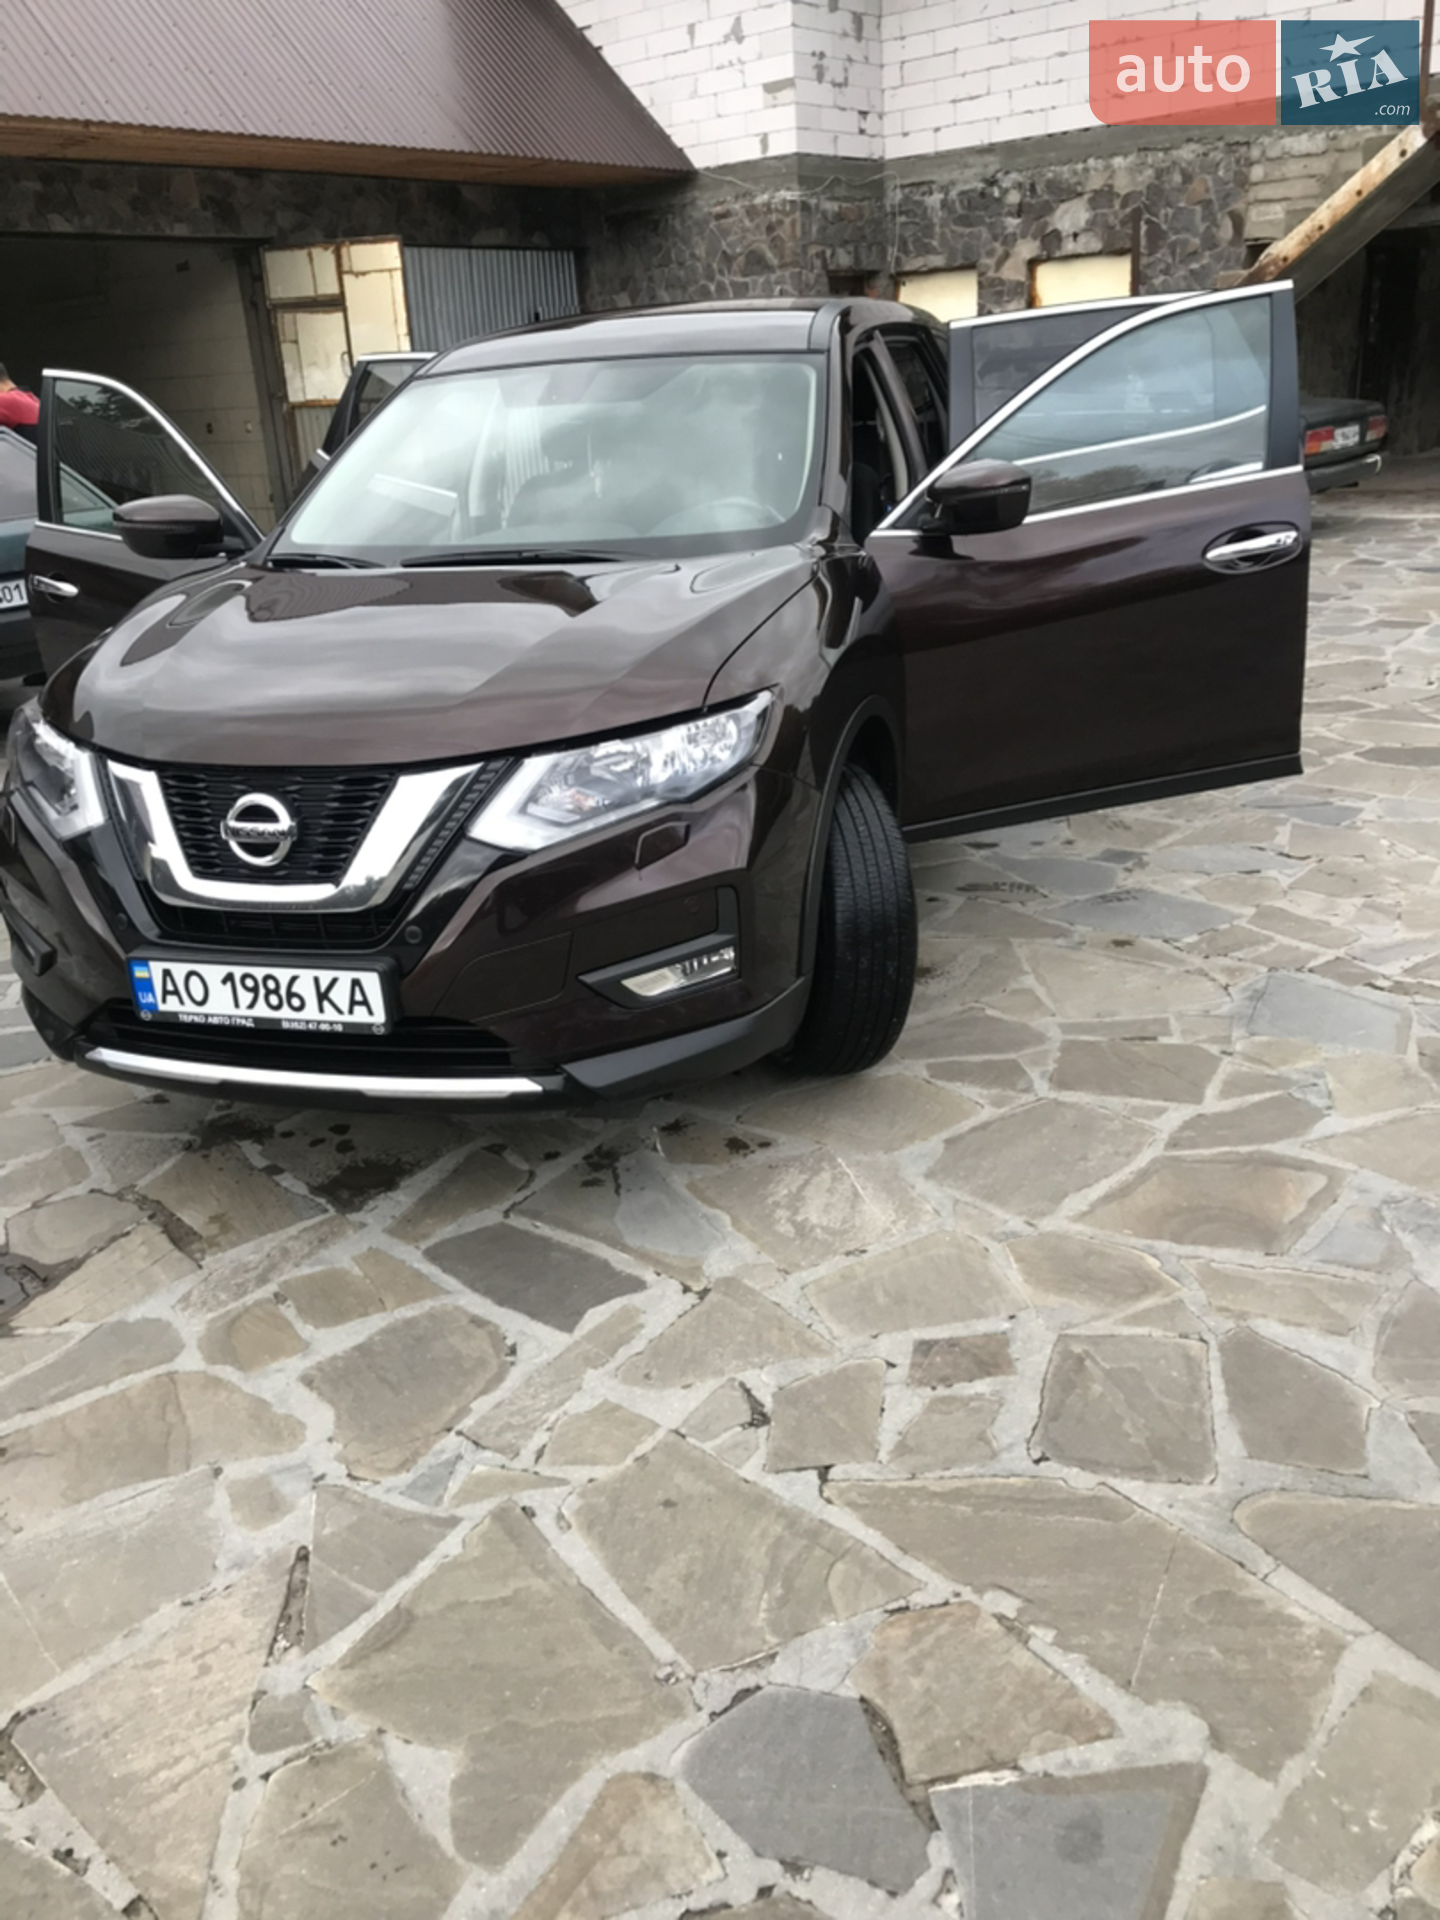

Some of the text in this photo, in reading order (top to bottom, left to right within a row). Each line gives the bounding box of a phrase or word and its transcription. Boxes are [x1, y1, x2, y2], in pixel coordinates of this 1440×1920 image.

[227, 825, 286, 840] NISSAN
[138, 992, 155, 1004] UA
[160, 968, 375, 1017] AO 1986 KA
